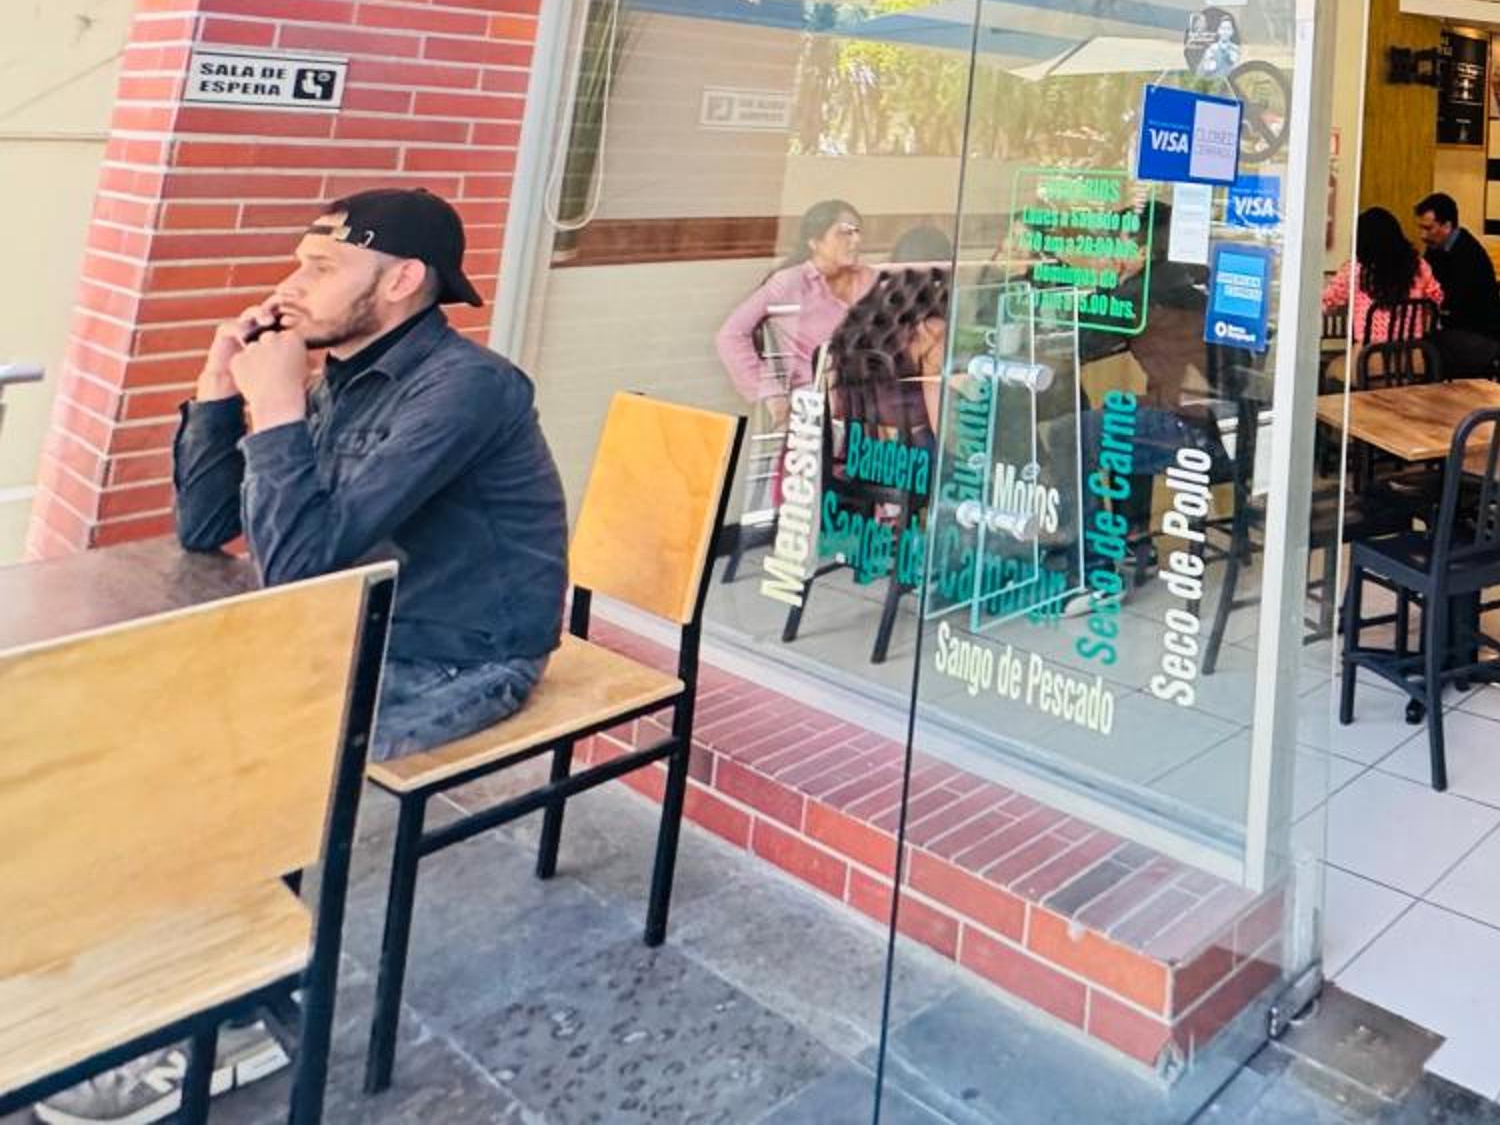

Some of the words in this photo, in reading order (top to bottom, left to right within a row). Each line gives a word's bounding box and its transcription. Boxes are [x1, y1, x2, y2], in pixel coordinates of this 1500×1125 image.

[199, 79, 281, 96] ESPERA
[200, 62, 255, 78] SALA
[260, 66, 288, 80] DE
[1148, 127, 1190, 154] VISA
[1233, 195, 1275, 218] VISA
[1074, 290, 1109, 316] 5.00
[846, 421, 930, 496] Bandera
[1088, 388, 1138, 500] Carne
[760, 387, 826, 607] Menestra
[1162, 447, 1213, 543] Pollo
[1086, 512, 1129, 561] de
[1158, 550, 1206, 601] de
[1075, 570, 1125, 666] Seco
[934, 620, 994, 697] Sango
[996, 643, 1023, 701] de
[1025, 651, 1115, 736] Pescado
[1151, 608, 1201, 707] Seco
